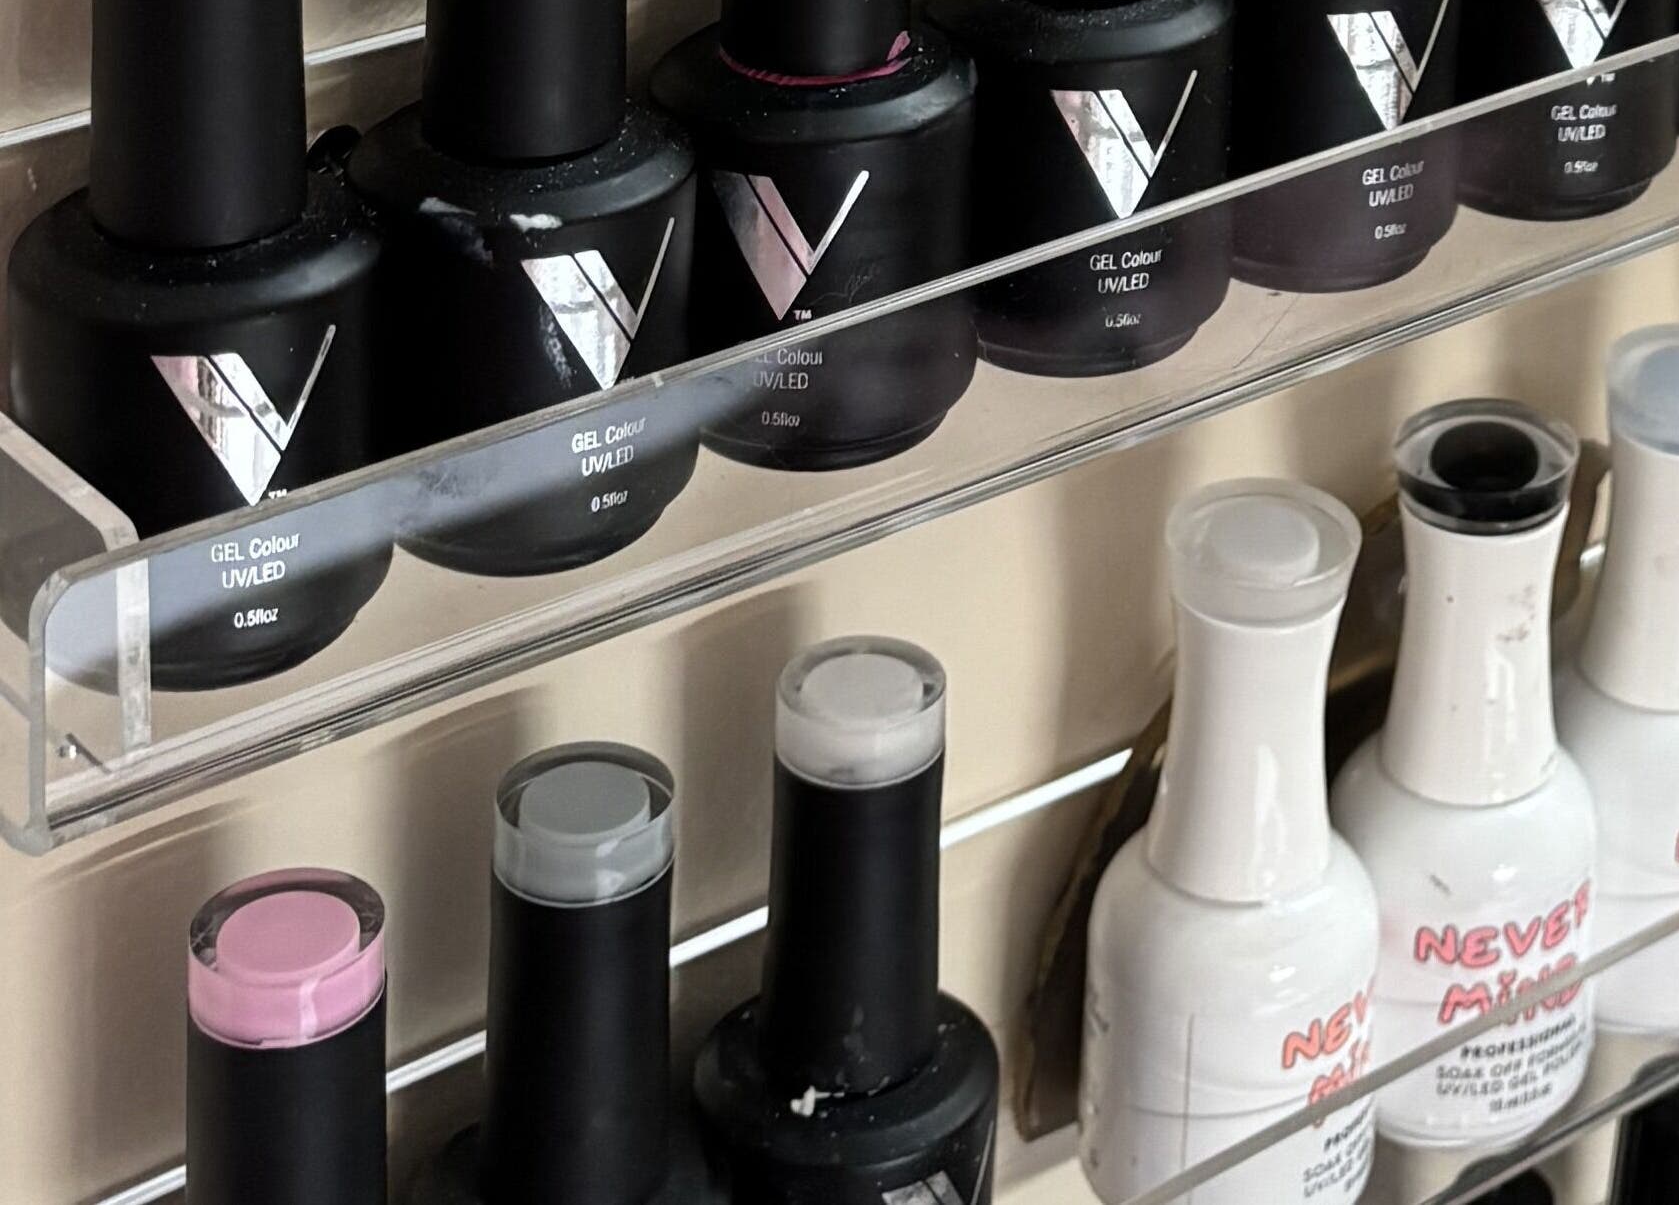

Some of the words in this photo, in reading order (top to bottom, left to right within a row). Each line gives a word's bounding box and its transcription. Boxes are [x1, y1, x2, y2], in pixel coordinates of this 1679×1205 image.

[1089, 253, 1118, 271] GEL
[1121, 248, 1163, 269] Colour
[1097, 272, 1150, 294] UV/LED
[753, 370, 809, 390] UV/LED
[571, 430, 602, 454] GEL
[604, 416, 647, 445] Colour
[581, 444, 634, 477] UV/LED
[210, 542, 245, 563] GEL
[249, 532, 300, 560] Colour
[221, 560, 286, 589] UV/LED
